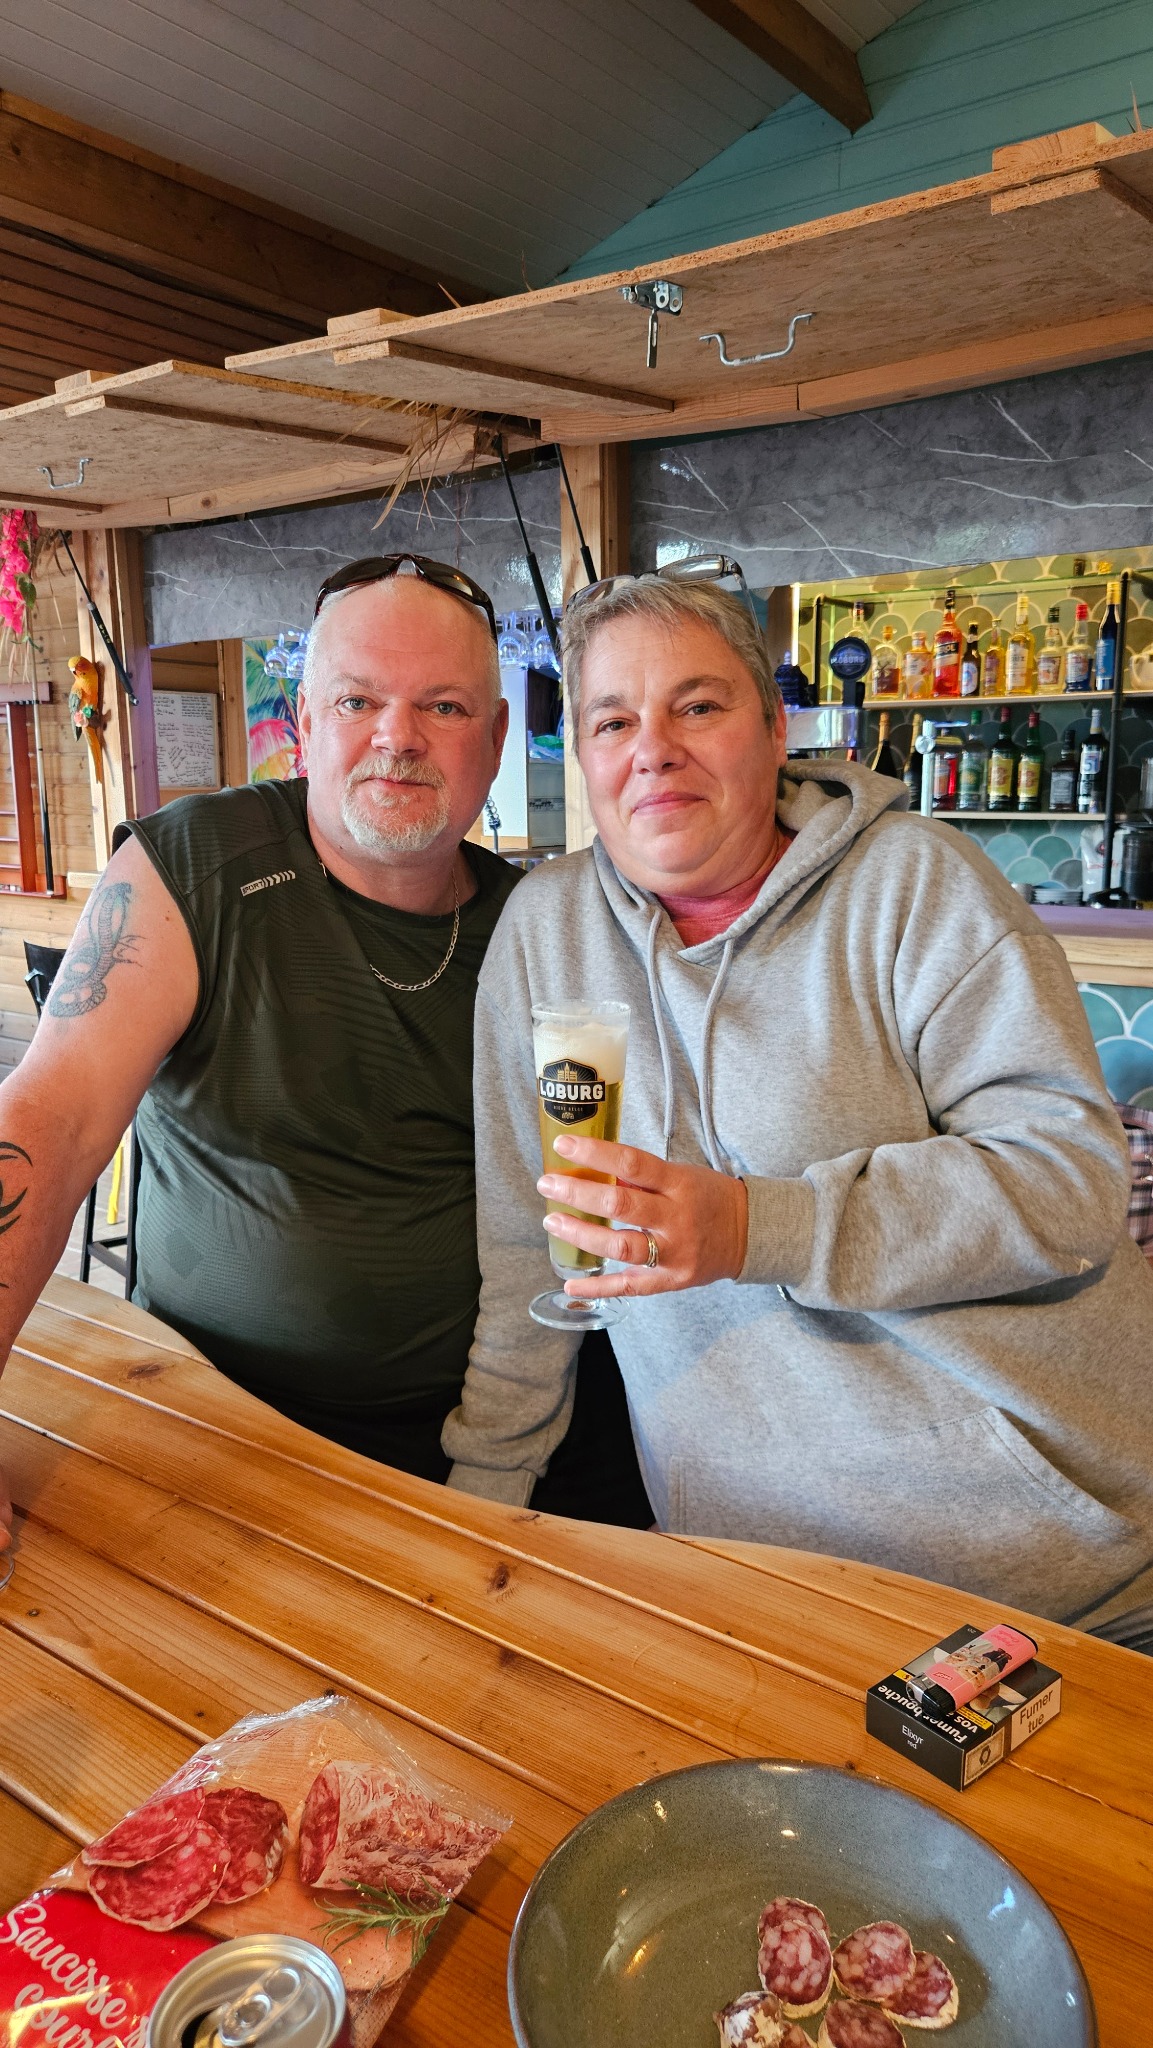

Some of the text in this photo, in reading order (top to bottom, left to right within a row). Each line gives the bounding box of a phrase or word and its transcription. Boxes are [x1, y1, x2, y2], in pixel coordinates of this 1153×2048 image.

[540, 1079, 604, 1101] LOBURG
[877, 1684, 923, 1718] bouche
[1020, 1689, 1054, 1725] Fumer
[901, 1724, 924, 1745] Elixyr
[954, 1715, 979, 1733] vos
[1027, 1713, 1045, 1734] tue
[0, 1902, 128, 2029] Saucisse
